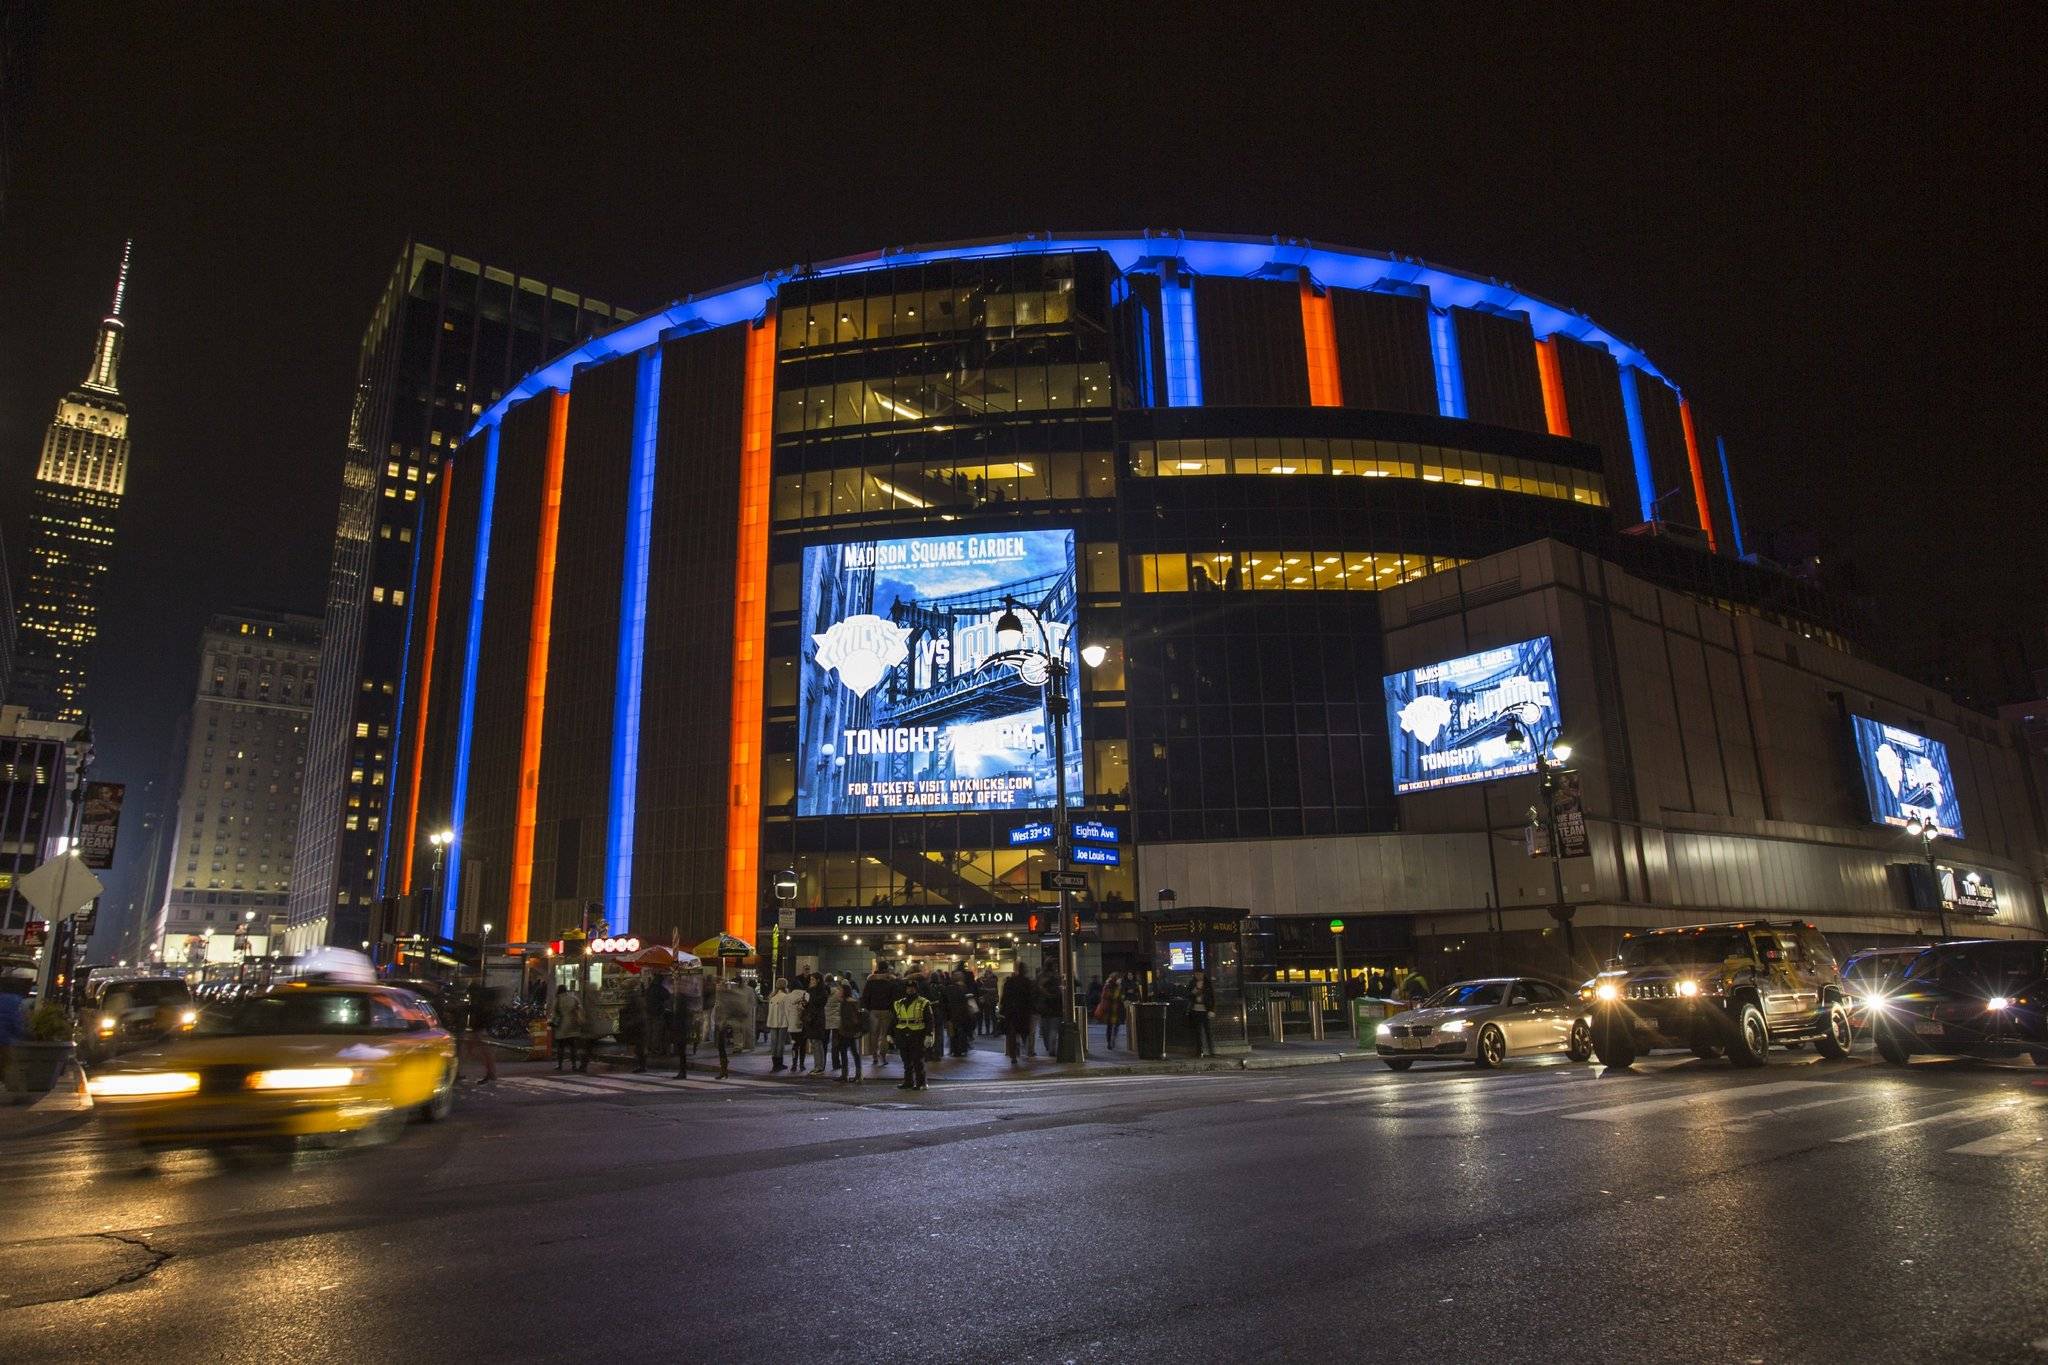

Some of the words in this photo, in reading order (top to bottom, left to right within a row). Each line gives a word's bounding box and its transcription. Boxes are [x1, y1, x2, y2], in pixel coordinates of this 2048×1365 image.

[844, 543, 907, 568] MADISON
[911, 540, 965, 563] SQUARE
[921, 638, 950, 666] VS
[843, 726, 939, 756] TONIGHT
[1420, 746, 1475, 772] TONIGHT
[848, 782, 869, 796] FOR
[871, 779, 915, 795] TICKETS
[918, 778, 946, 793] VISIT
[949, 776, 1033, 792] NYKNICKS.COM
[865, 794, 880, 808] OR
[883, 793, 902, 807] THE
[906, 791, 949, 806] GARDEN
[952, 791, 973, 805] BOX
[976, 789, 1015, 804] OFFICE
[1012, 831, 1029, 842] West
[1030, 828, 1042, 840] 33rd
[1043, 826, 1051, 837] St
[1075, 825, 1099, 838] Eighth
[1101, 828, 1115, 839] Ave
[1558, 825, 1585, 838] TEAM
[80, 837, 114, 849] TEAM
[1077, 849, 1089, 860] Joe
[1089, 850, 1105, 861] Louis
[837, 913, 947, 925] PENNSYLVANIA
[953, 912, 1013, 923] STATION
